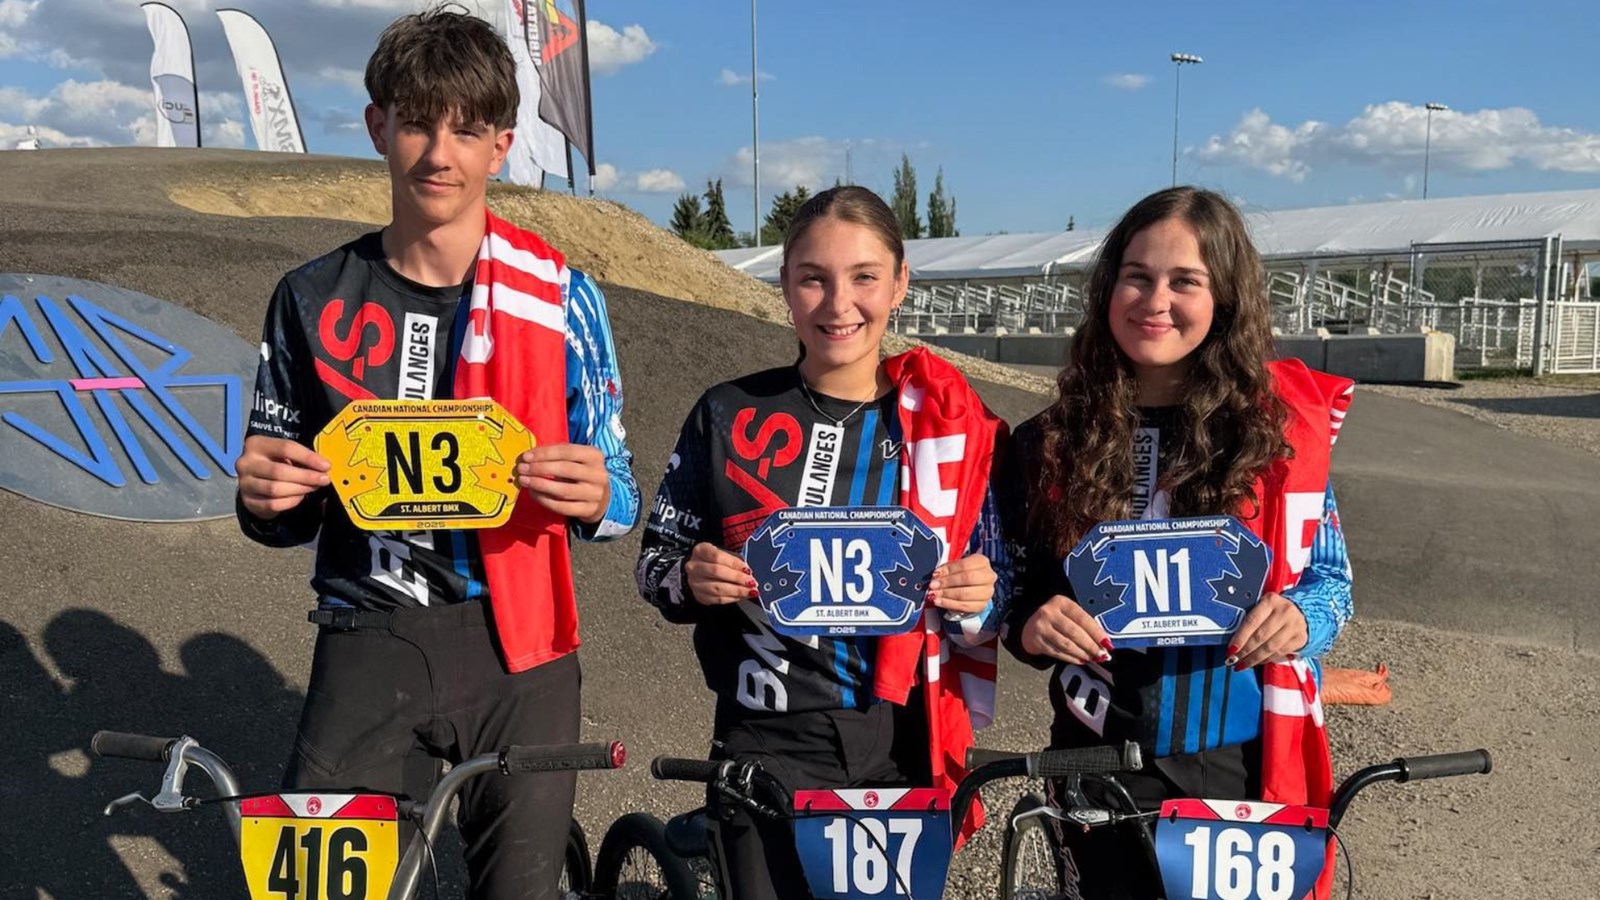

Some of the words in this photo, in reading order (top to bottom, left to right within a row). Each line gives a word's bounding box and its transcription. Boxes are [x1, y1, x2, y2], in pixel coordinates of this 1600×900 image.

[352, 405, 392, 413] CANADIAN
[393, 405, 431, 413] NATIONAL
[432, 404, 494, 413] CHAMPIONSHIPS
[384, 431, 462, 495] N3
[804, 430, 837, 507] ULANGES
[400, 504, 412, 513] ST.
[413, 503, 441, 512] ALBERT
[442, 503, 459, 512] BMX
[779, 511, 814, 519] CANADIAN
[814, 511, 848, 519] NATIONAL
[849, 511, 906, 519] CHAMPIONSHIPS
[1099, 525, 1135, 534] CANADIAN
[1135, 523, 1170, 532] NATIONAL
[1171, 519, 1230, 530] CHAMPIONSHIPS
[809, 538, 874, 603] N3
[1133, 548, 1192, 613] N1
[816, 609, 826, 617] ST.
[826, 609, 853, 617] ALBERT
[853, 609, 869, 617] BMX
[1142, 621, 1152, 629] ST.
[1153, 620, 1181, 628] ALBERT
[1182, 619, 1198, 627] BMX
[1156, 637, 1186, 645] 2025
[268, 825, 367, 900] 416
[824, 817, 923, 895] 187
[1184, 826, 1296, 900] 168
